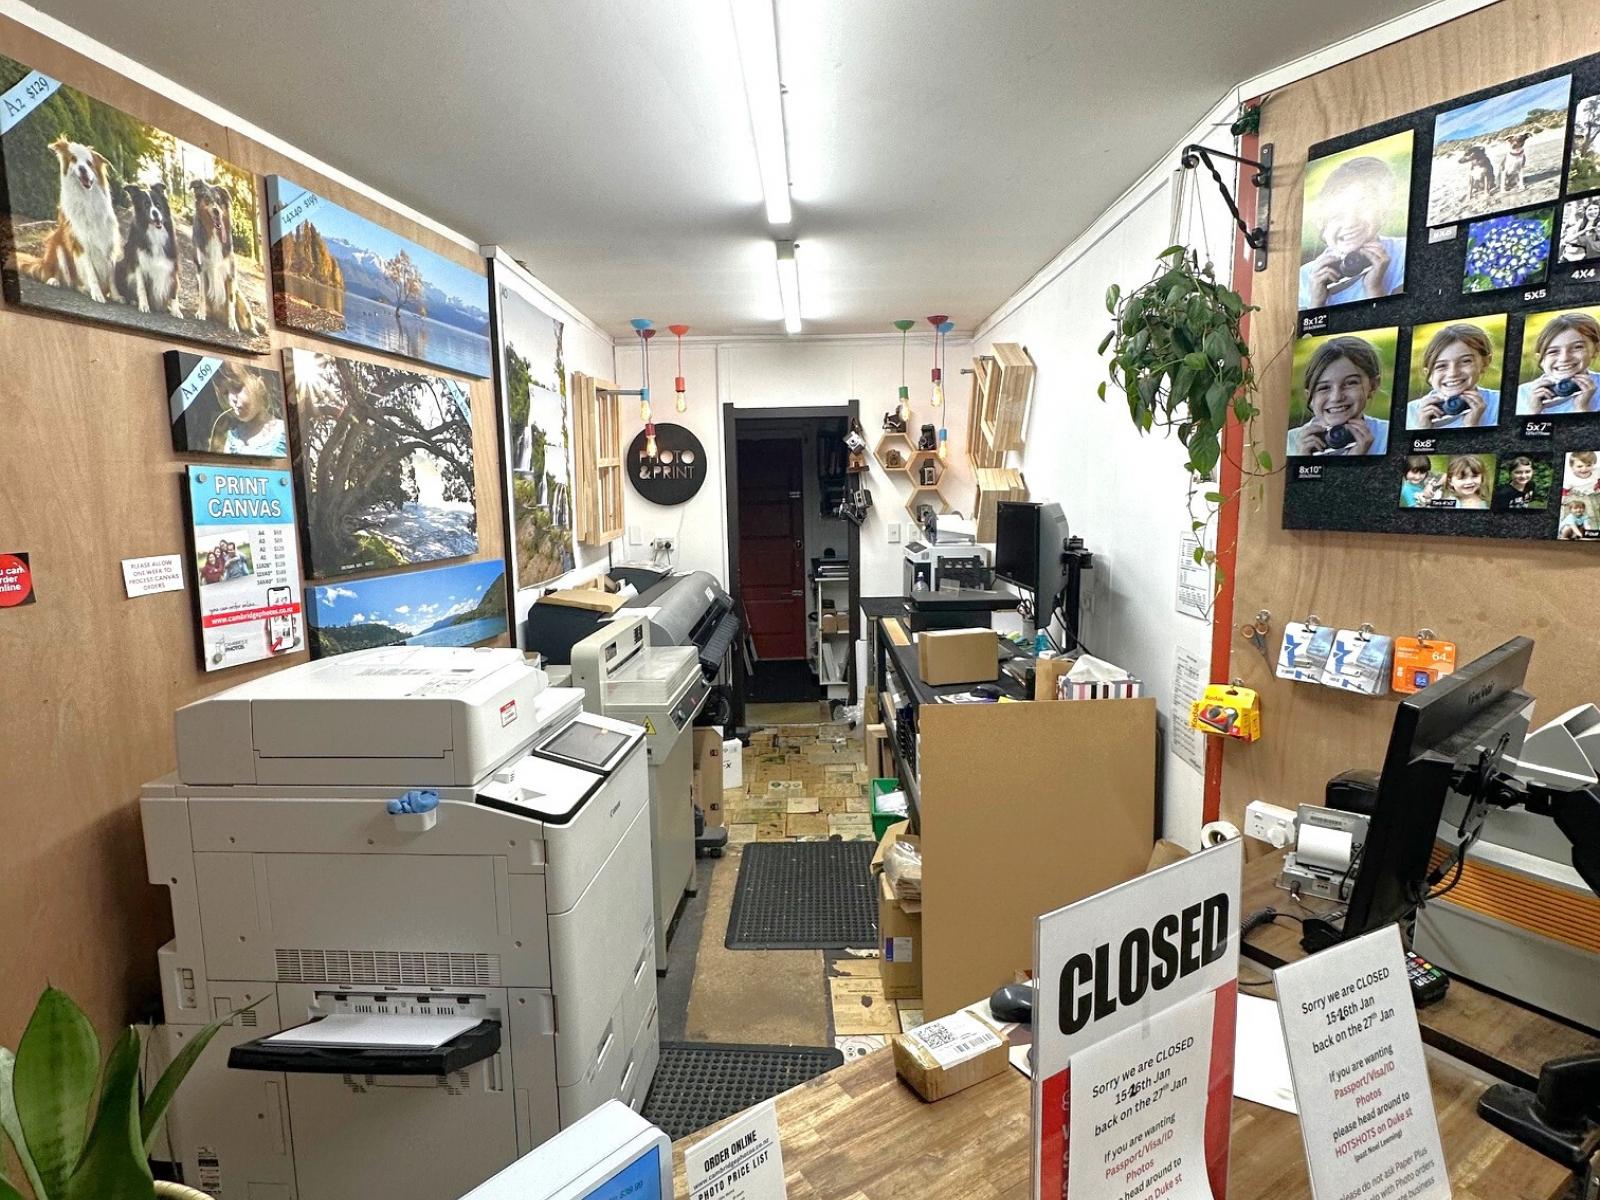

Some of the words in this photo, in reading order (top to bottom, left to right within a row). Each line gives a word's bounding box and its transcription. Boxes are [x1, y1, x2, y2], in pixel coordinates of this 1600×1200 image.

[3, 98, 26, 117] A2
[26, 77, 49, 99] $129
[1571, 268, 1596, 279] 4X4
[1524, 289, 1546, 300] 5X5
[181, 384, 199, 400] A4
[214, 475, 269, 496] PRINT
[208, 498, 282, 518] CANVAS
[0, 575, 18, 584] rder
[131, 561, 150, 569] PLEASE
[154, 573, 180, 581] CANVAS
[0, 584, 21, 592] nline
[1432, 651, 1446, 661] 64
[1191, 702, 1200, 728] Kodak
[1058, 892, 1230, 1036] CLOSED
[1301, 996, 1326, 1015] Sorry
[1327, 991, 1341, 1003] we
[1341, 985, 1356, 999] are
[1356, 967, 1390, 991] CLOSED
[1360, 995, 1376, 1011] Jan
[1312, 1034, 1334, 1054] back
[1335, 1030, 1347, 1043] on
[1348, 1022, 1362, 1038] the
[1363, 1013, 1377, 1031] 27th
[1379, 1007, 1395, 1023] Jan
[1092, 1074, 1121, 1098] Sorry
[1122, 1066, 1136, 1081] we
[1137, 1057, 1154, 1074] are
[1156, 1036, 1195, 1064] CLOSED
[1153, 1067, 1171, 1084] Jan
[1329, 1072, 1336, 1084] If
[1336, 1066, 1351, 1082] you
[1352, 1060, 1364, 1072] are
[1364, 1044, 1394, 1066] wanting
[1334, 1061, 1395, 1100] Passport/Visa/ID
[1094, 1114, 1119, 1137] back
[1120, 1107, 1133, 1122] on
[1135, 1095, 1151, 1113] the
[1152, 1082, 1169, 1103] 27th
[1170, 1075, 1188, 1092] Jan
[1355, 1087, 1383, 1108] Photos
[1332, 1119, 1357, 1142] please
[1358, 1108, 1377, 1126] head
[1377, 1095, 1401, 1117] around
[1401, 1090, 1410, 1102] to
[1104, 1150, 1111, 1163] If
[1112, 1143, 1127, 1160] you
[1129, 1133, 1143, 1147] are
[1144, 1112, 1176, 1138] wanting
[1335, 1126, 1377, 1158] HOTSHOTS
[1377, 1122, 1387, 1135] on
[1387, 1112, 1405, 1130] Duke
[1405, 1107, 1413, 1119] st
[704, 1147, 730, 1172] ORDER
[731, 1129, 757, 1156] ONLINE
[1105, 1129, 1174, 1180] Passport/Visa/ID
[698, 1180, 725, 1200] PHOTO
[727, 1162, 750, 1186] PRICE
[752, 1150, 769, 1169] LIST
[1125, 1181, 1144, 1200] head
[1145, 1161, 1172, 1188] around
[1173, 1157, 1182, 1168] to
[1126, 1158, 1154, 1183] Photos
[1362, 1181, 1372, 1193] do
[1372, 1174, 1384, 1187] not
[1384, 1165, 1395, 1179] ask
[1395, 1154, 1414, 1172] Paper
[1413, 1146, 1428, 1160] Plus
[1380, 1183, 1396, 1199] with
[1395, 1172, 1414, 1190] Photo
[1415, 1159, 1435, 1177] orders
[1154, 1179, 1174, 1199] Duke
[1175, 1173, 1183, 1185] st
[1408, 1176, 1435, 1198] business
